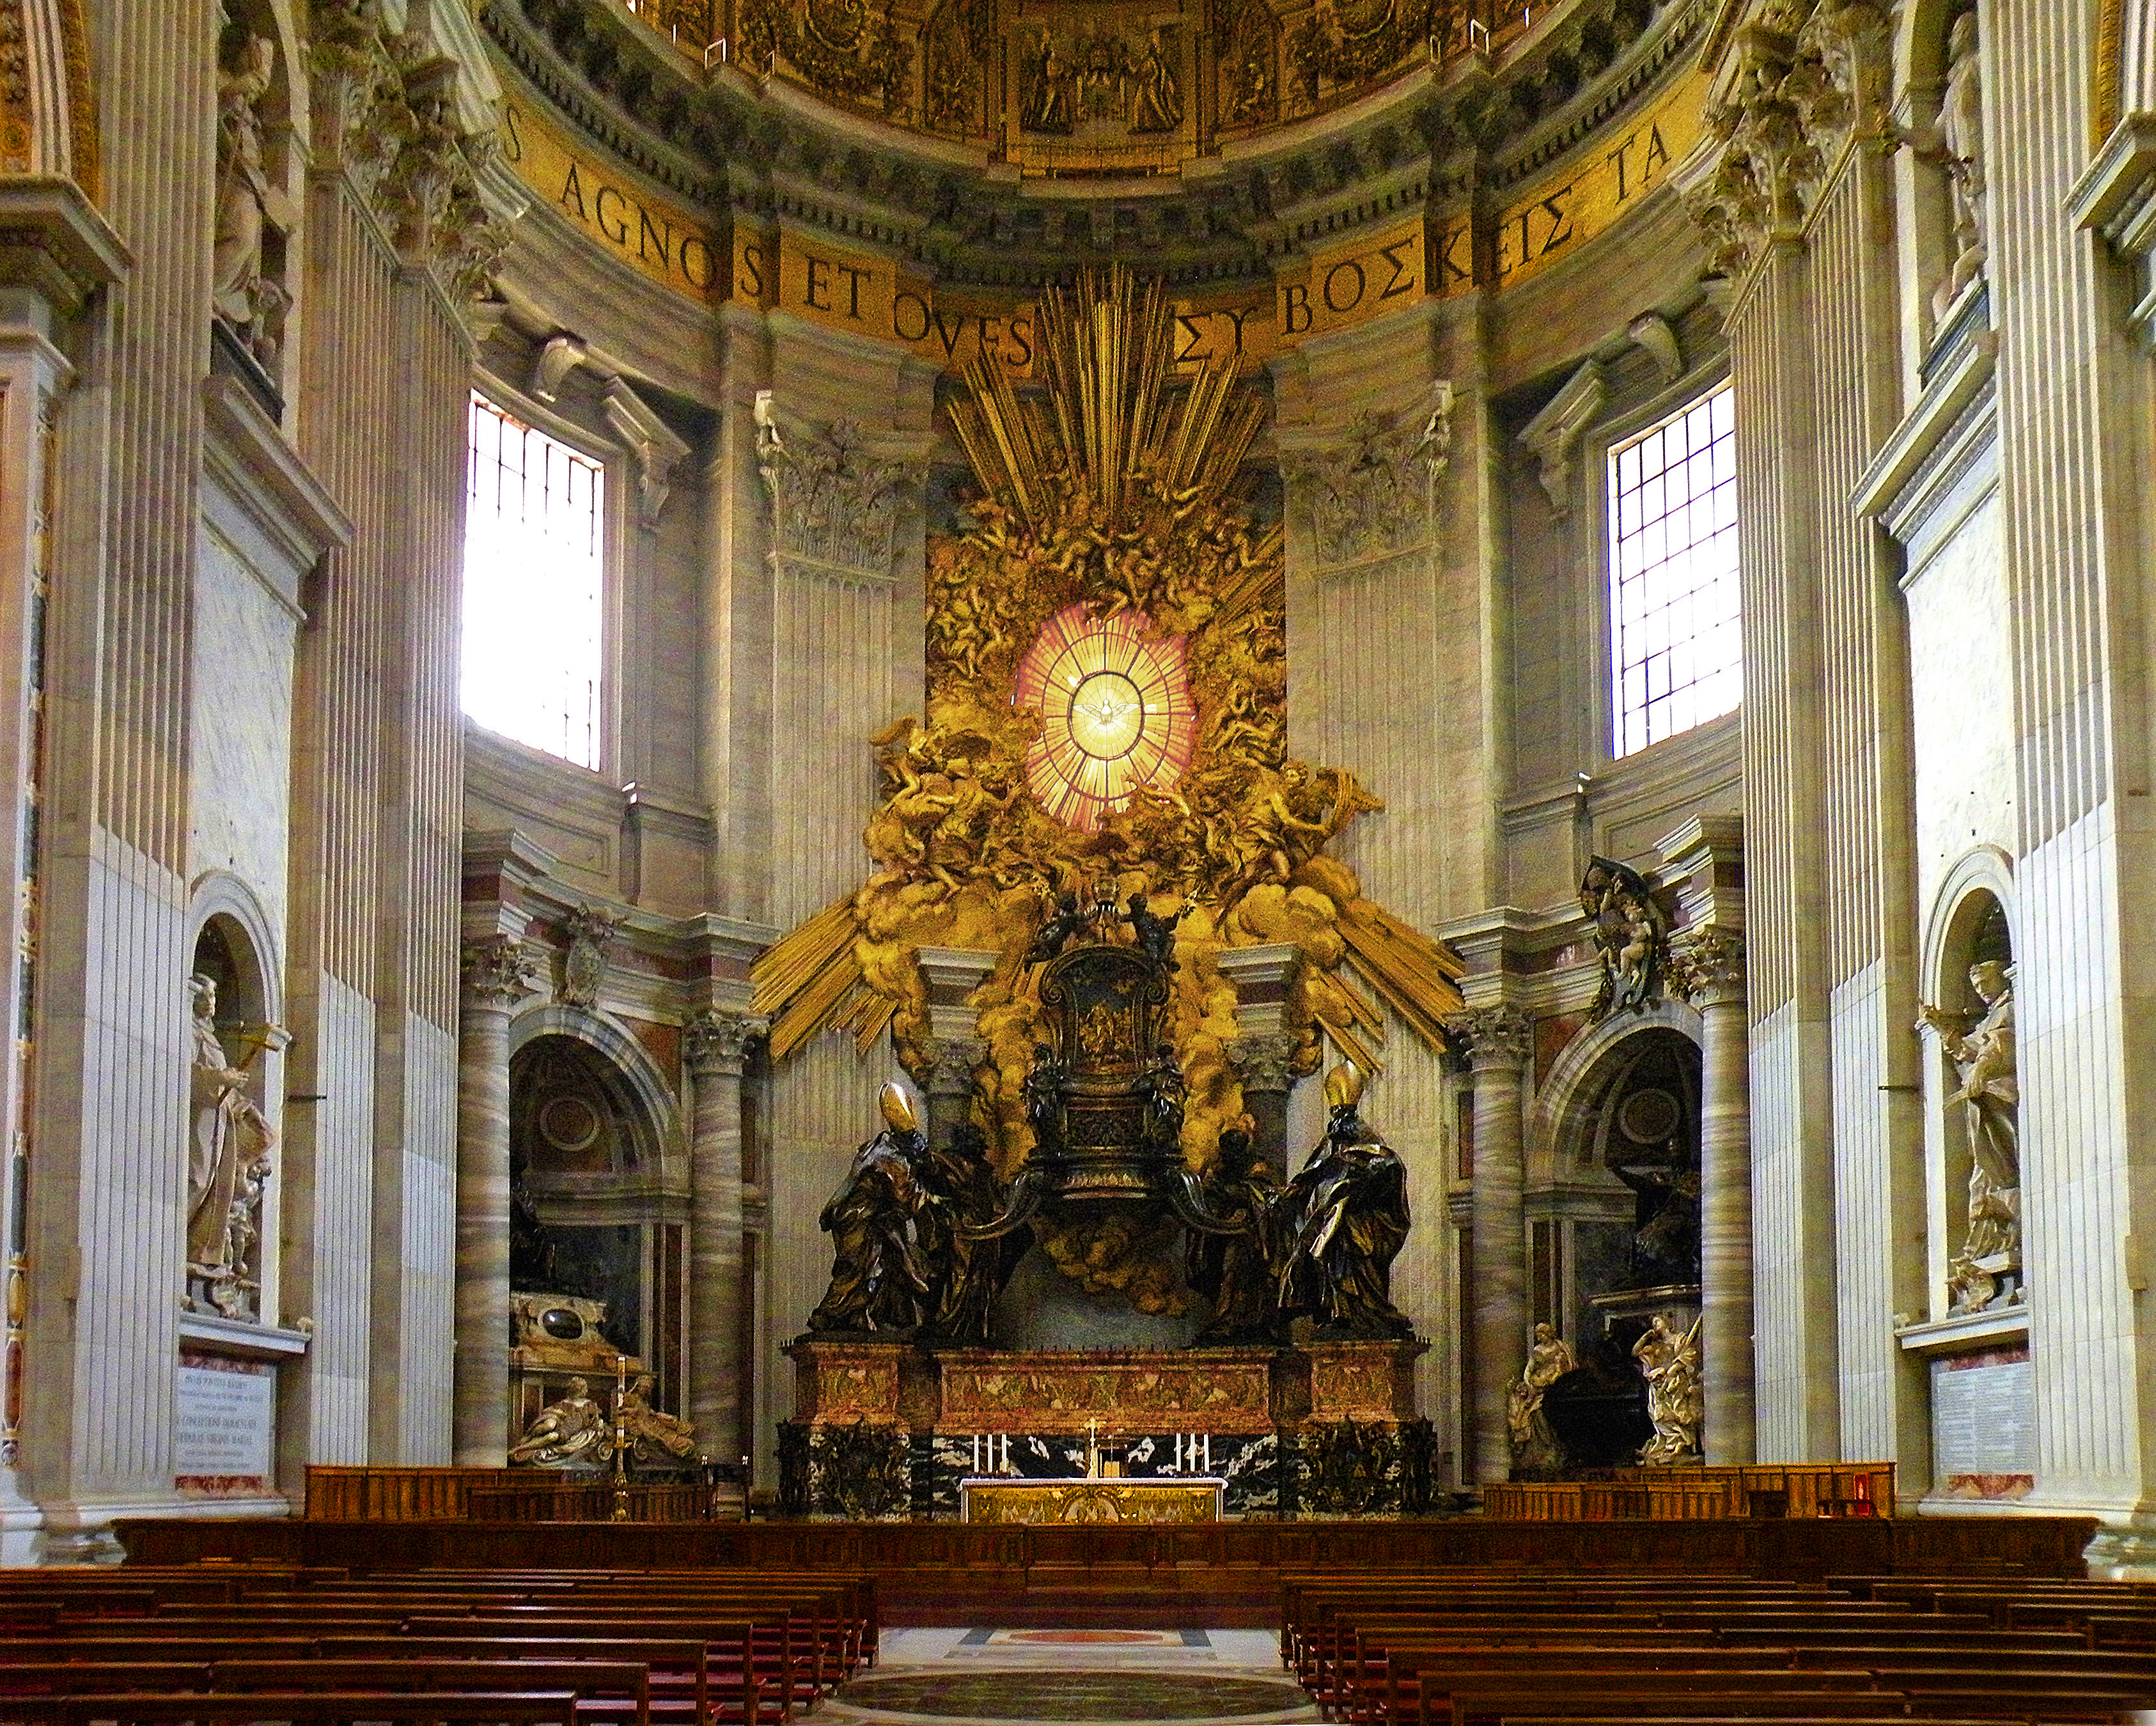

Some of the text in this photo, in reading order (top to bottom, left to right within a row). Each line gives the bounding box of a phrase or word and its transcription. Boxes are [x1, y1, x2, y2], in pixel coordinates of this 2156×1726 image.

[561, 162, 764, 297] AGNOS
[804, 255, 872, 319] ET
[894, 293, 1031, 366] OVES
